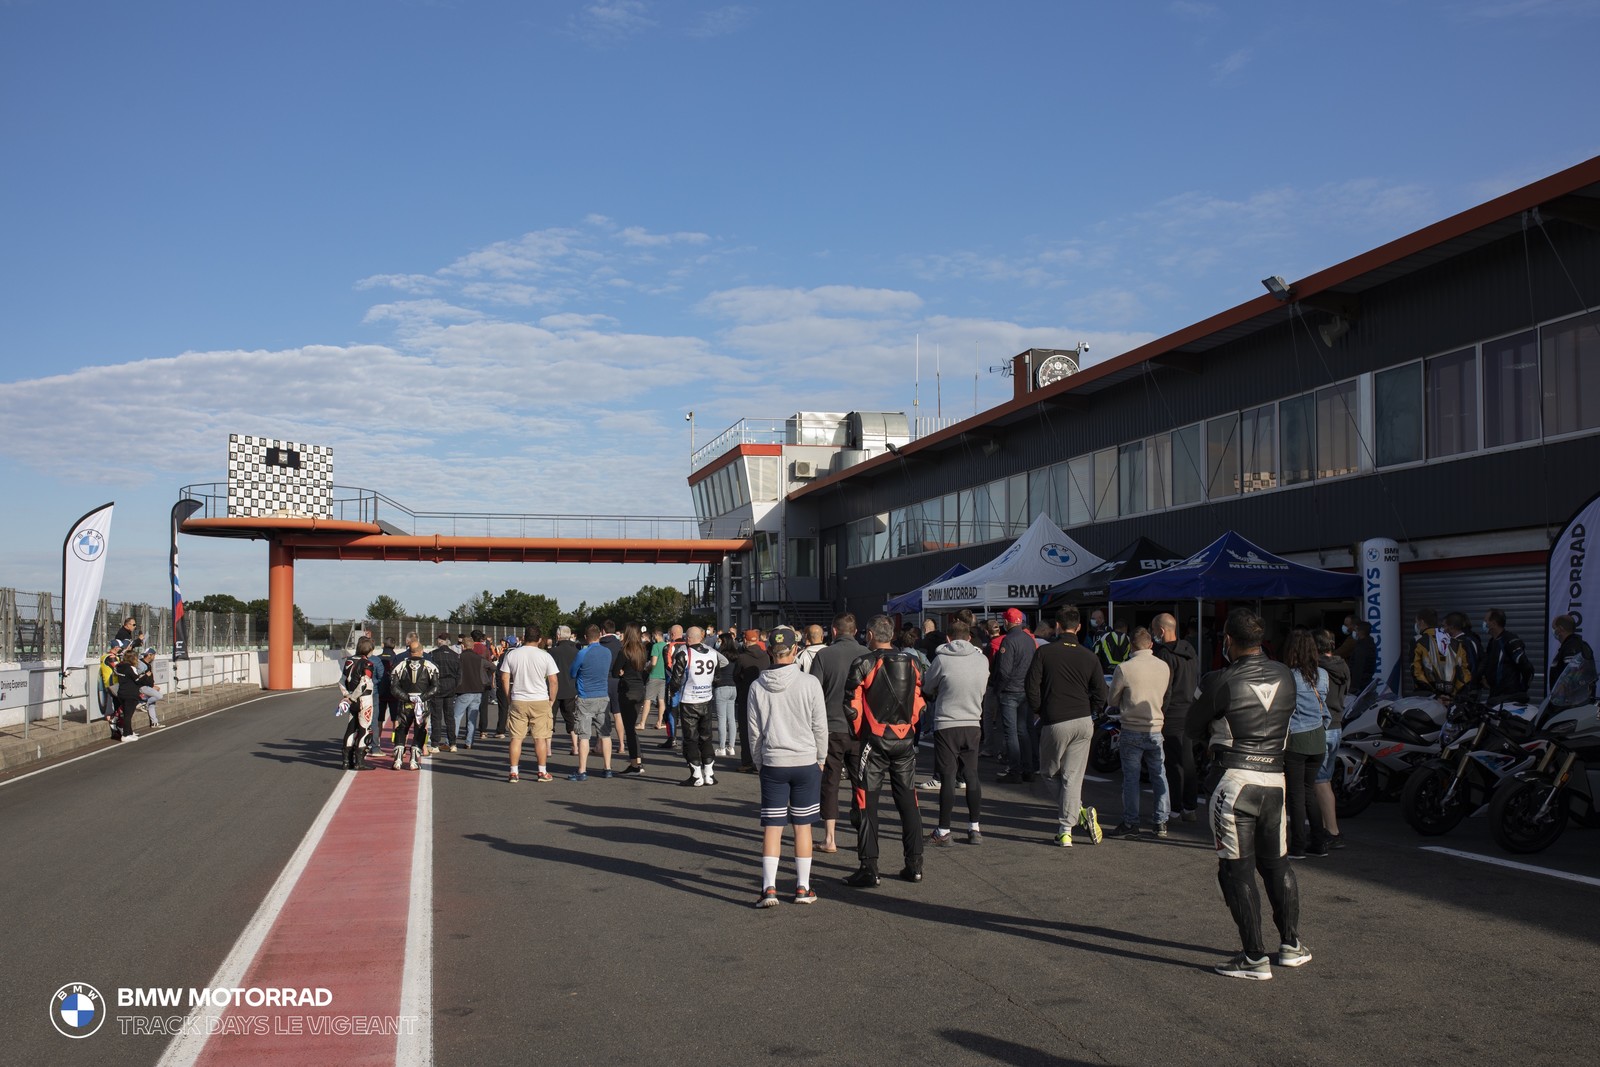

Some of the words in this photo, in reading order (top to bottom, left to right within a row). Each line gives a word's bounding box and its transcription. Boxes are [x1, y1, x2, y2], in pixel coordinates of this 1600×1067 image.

[78, 531, 102, 540] BMW
[1228, 563, 1290, 571] MICHELIN
[928, 589, 943, 601] BMW
[943, 586, 978, 600] MOTORRAD
[694, 659, 715, 676] 39
[0, 681, 12, 692] Driving
[12, 679, 28, 689] Experience
